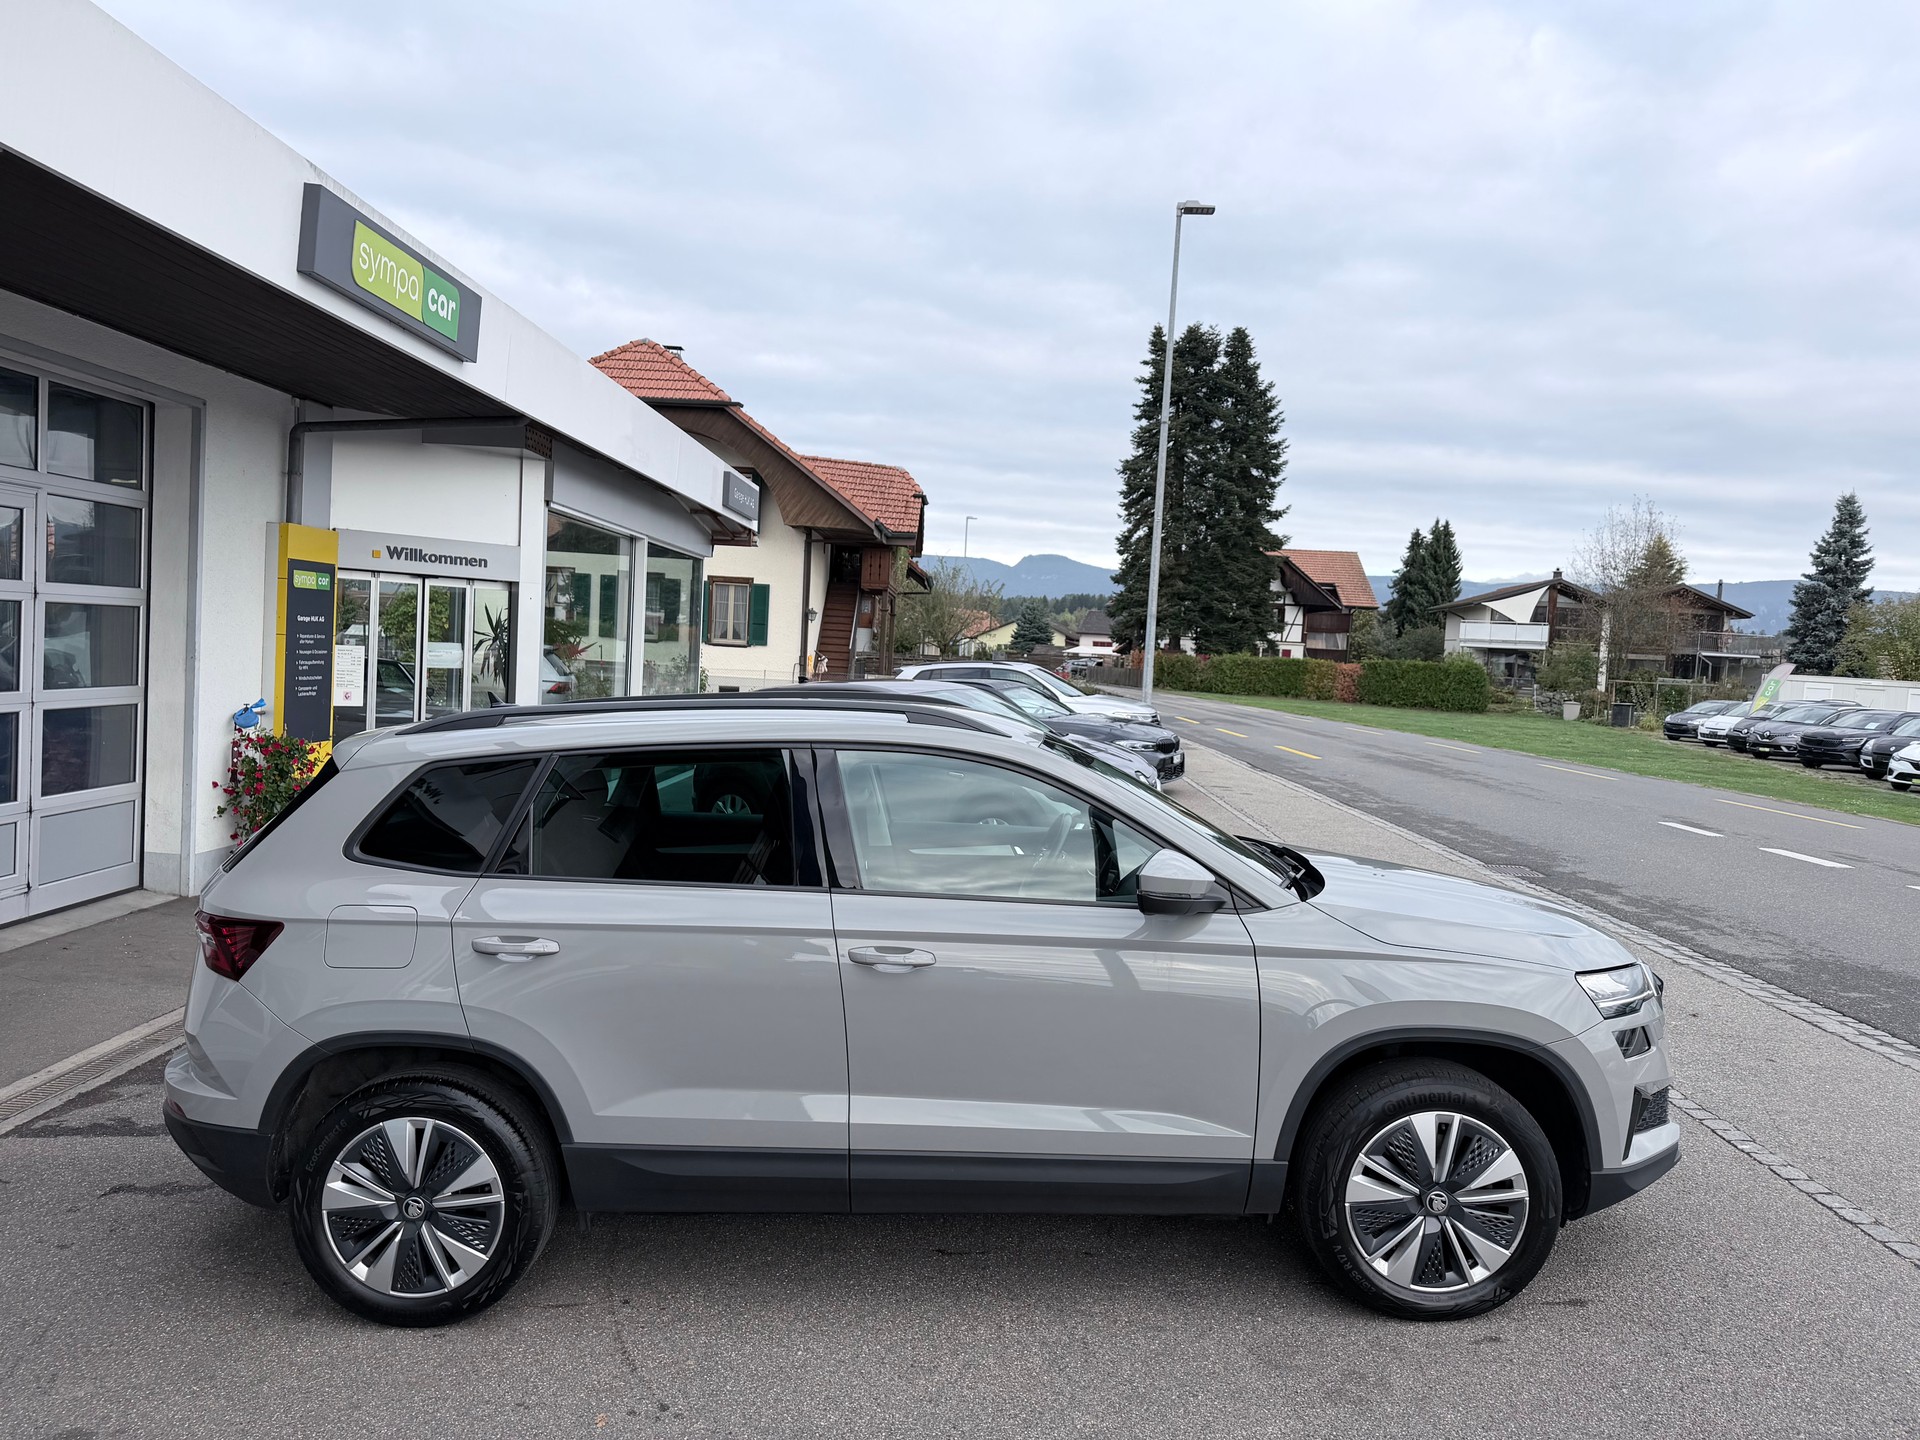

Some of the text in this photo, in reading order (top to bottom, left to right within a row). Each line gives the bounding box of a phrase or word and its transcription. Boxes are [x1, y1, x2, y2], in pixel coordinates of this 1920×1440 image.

[359, 242, 456, 321] sympa car
[386, 545, 488, 568] Willkommen
[294, 574, 329, 586] sympa car
[297, 614, 311, 622] Garage
[1764, 680, 1777, 696] car
[1382, 1091, 1466, 1115] Continental
[305, 1119, 347, 1172] EcoContact 6
